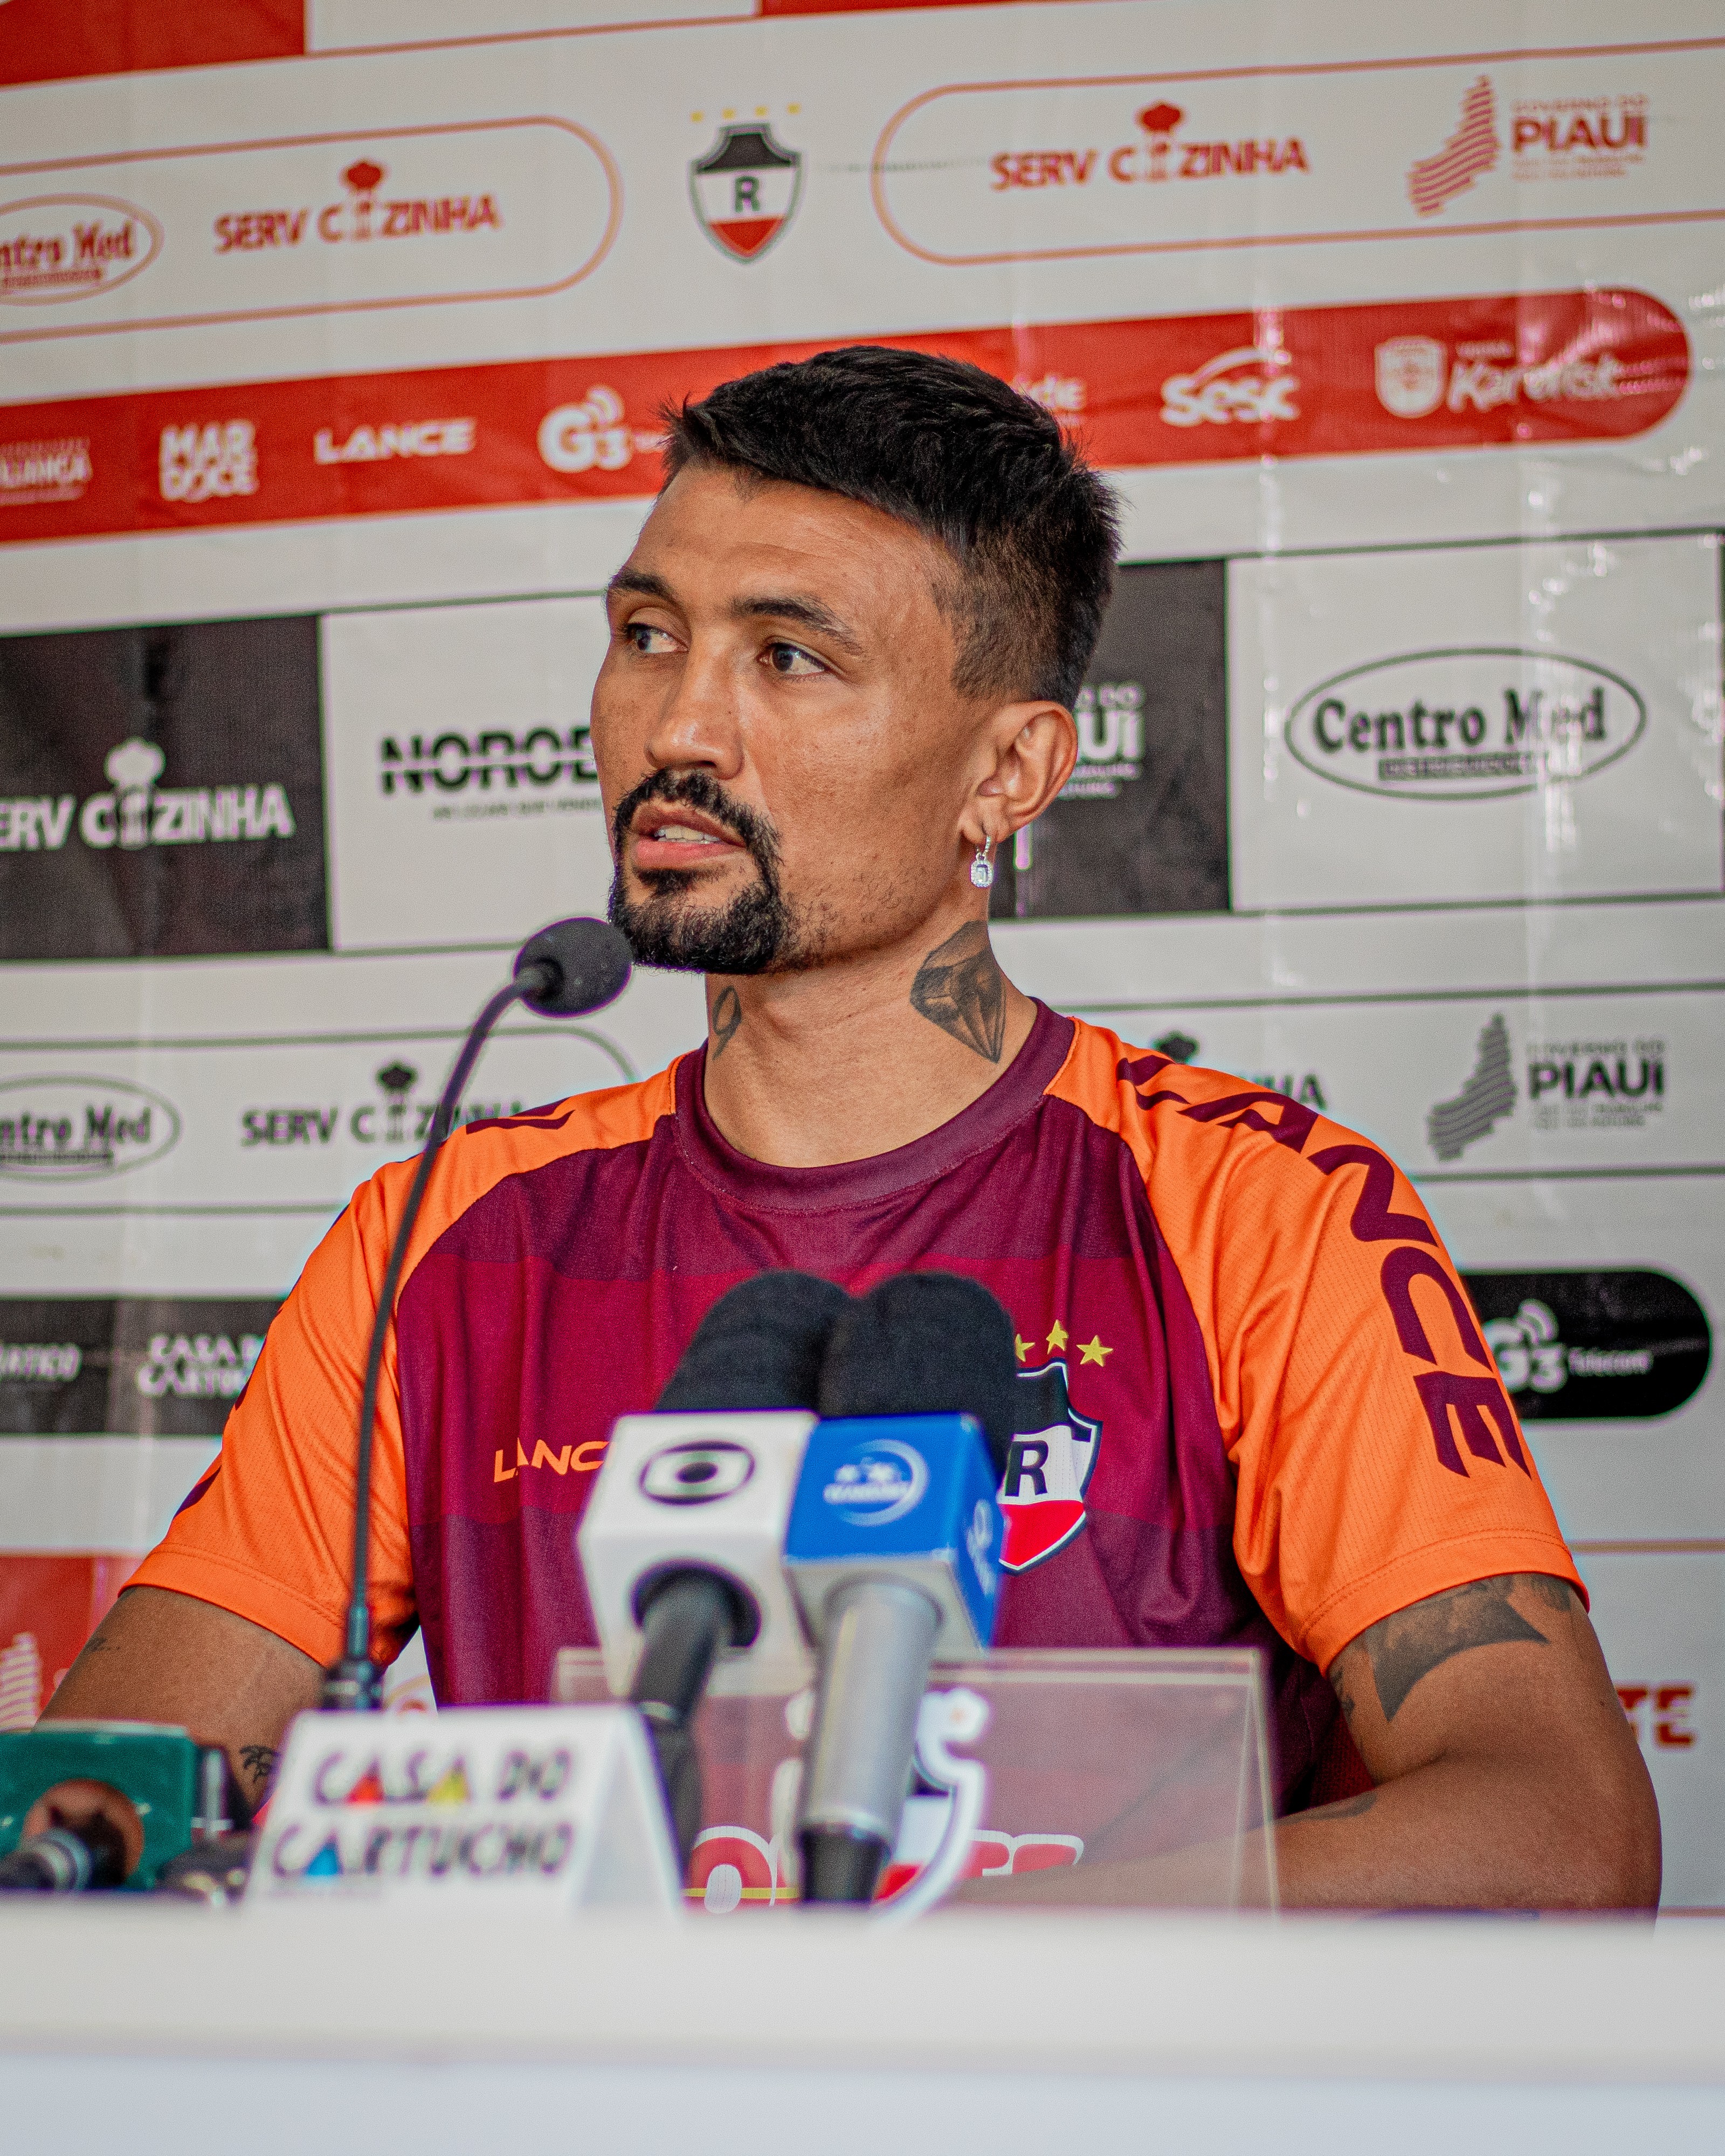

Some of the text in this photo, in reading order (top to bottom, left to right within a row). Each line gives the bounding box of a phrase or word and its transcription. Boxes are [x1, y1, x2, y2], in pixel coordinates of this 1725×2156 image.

[990, 149, 1098, 192] SERV
[734, 176, 761, 213] R
[215, 209, 309, 253] SERV
[161, 422, 256, 464] MAR
[315, 418, 476, 464] LANCE
[540, 404, 632, 473] G3
[1312, 697, 1486, 753] Centro
[241, 1105, 339, 1148] SERV
[1484, 1317, 1568, 1394] G3
[494, 1437, 609, 1483] LANC
[1005, 1440, 1048, 1497] R
[313, 1748, 571, 1806] CASA DO
